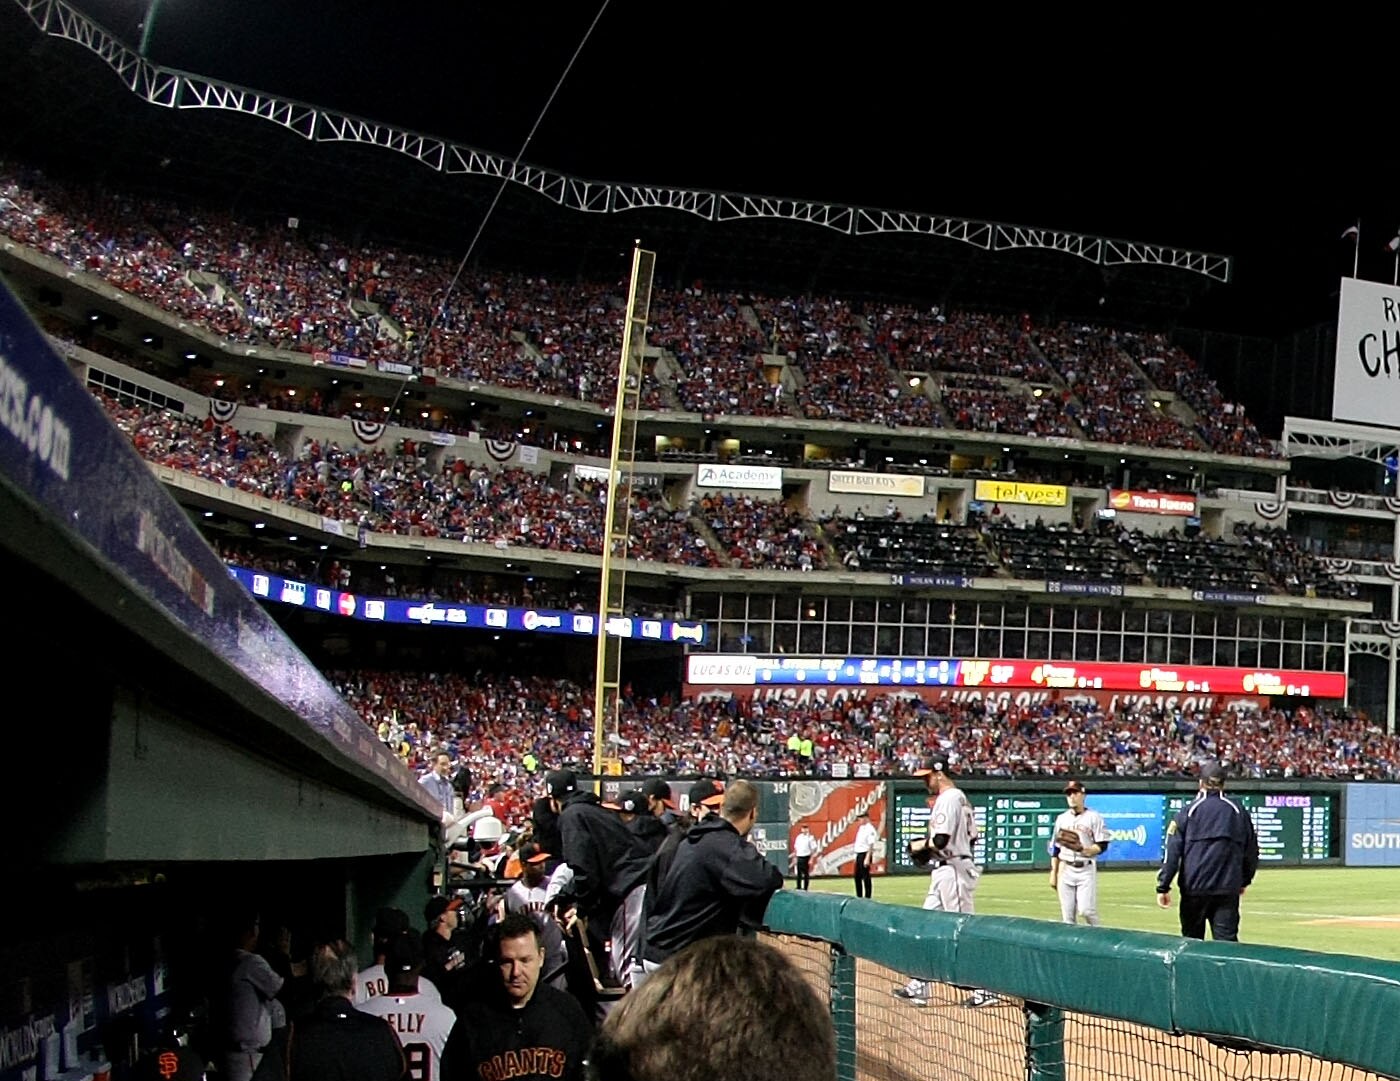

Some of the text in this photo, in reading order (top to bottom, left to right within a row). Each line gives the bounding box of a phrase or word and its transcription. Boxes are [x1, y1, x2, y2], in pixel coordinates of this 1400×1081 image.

[719, 469, 776, 482] Academy
[1132, 495, 1195, 512] Taco Bueno
[892, 575, 903, 585] 34
[693, 664, 732, 676] LUCAS
[773, 782, 788, 793] 354
[1264, 796, 1311, 807] RANGERS
[1012, 815, 1026, 823] 1.0
[1014, 828, 1021, 836] 0
[1014, 840, 1021, 848] 0
[1010, 852, 1017, 860] 0
[383, 1012, 426, 1034] ELLY
[158, 1051, 179, 1079] SF
